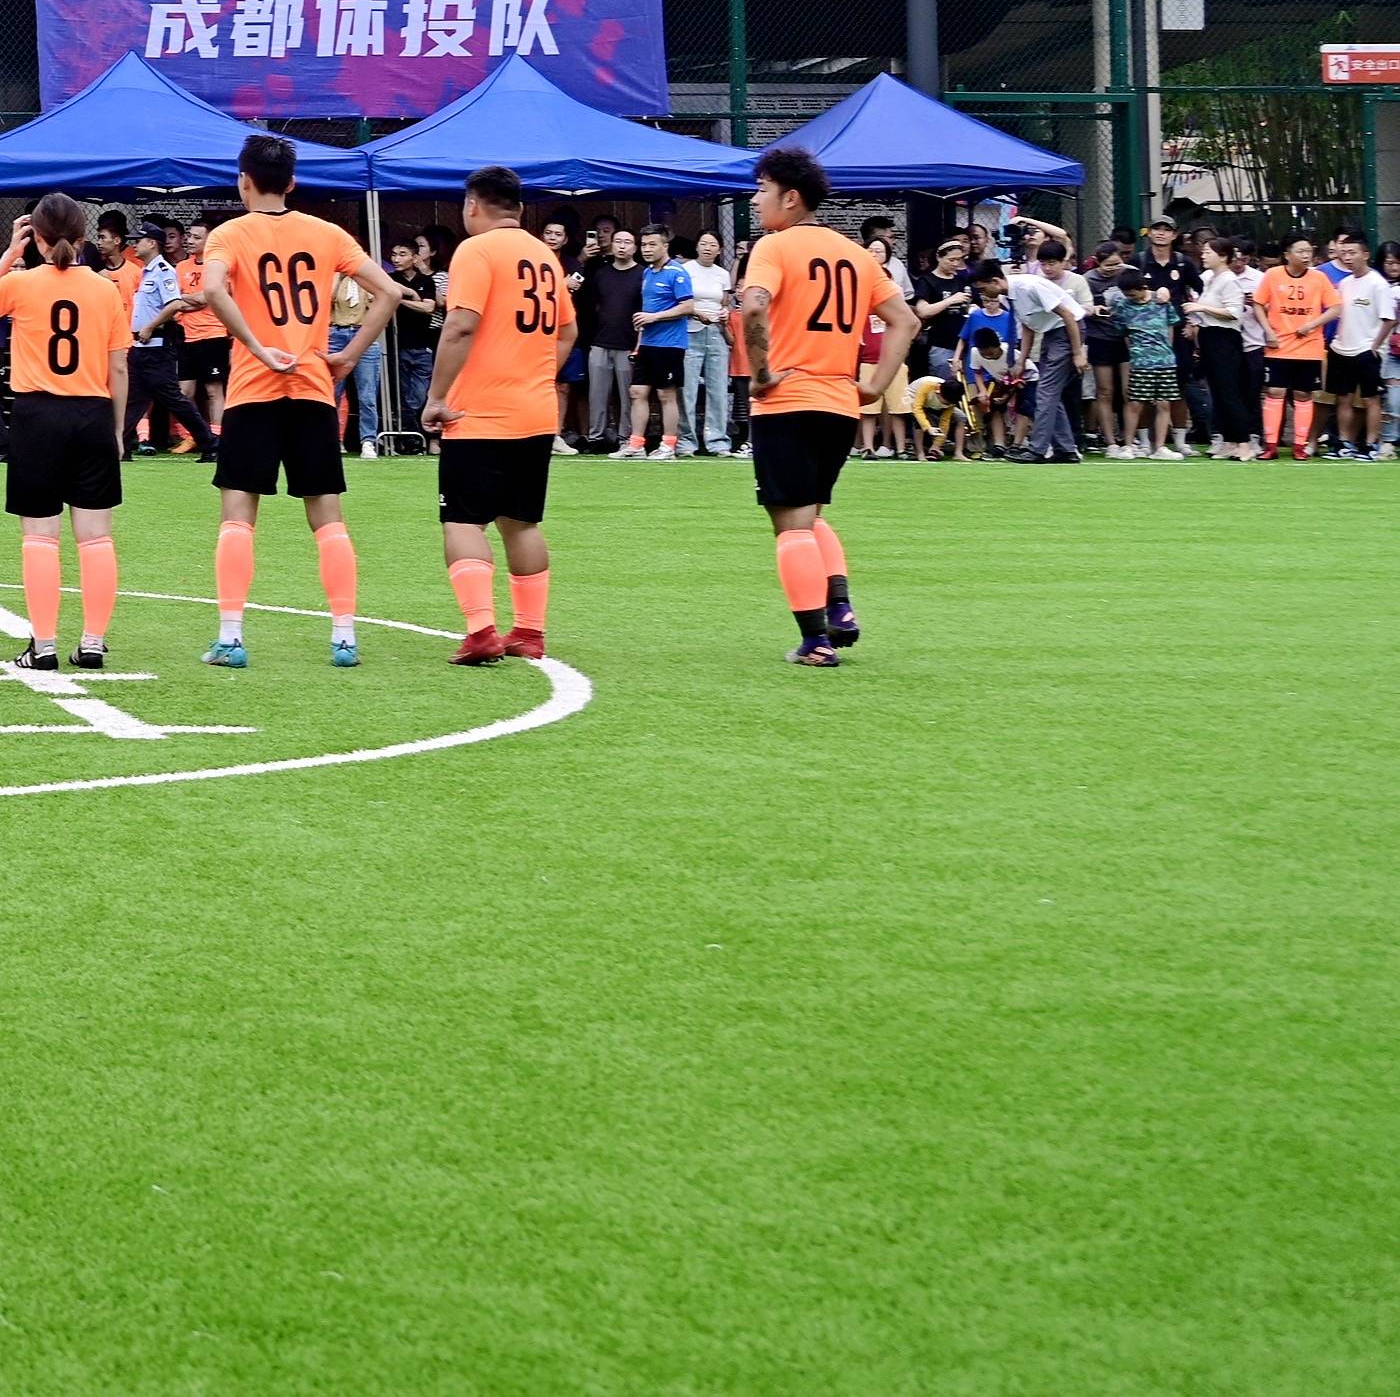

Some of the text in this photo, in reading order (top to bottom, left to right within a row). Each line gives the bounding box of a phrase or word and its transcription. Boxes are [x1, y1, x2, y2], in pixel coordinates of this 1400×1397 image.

[1350, 59, 1400, 70] 安全出口
[259, 251, 318, 326] 66
[516, 259, 557, 335] 33
[806, 257, 858, 334] 20
[1287, 285, 1305, 301] 26
[48, 299, 80, 376] 8
